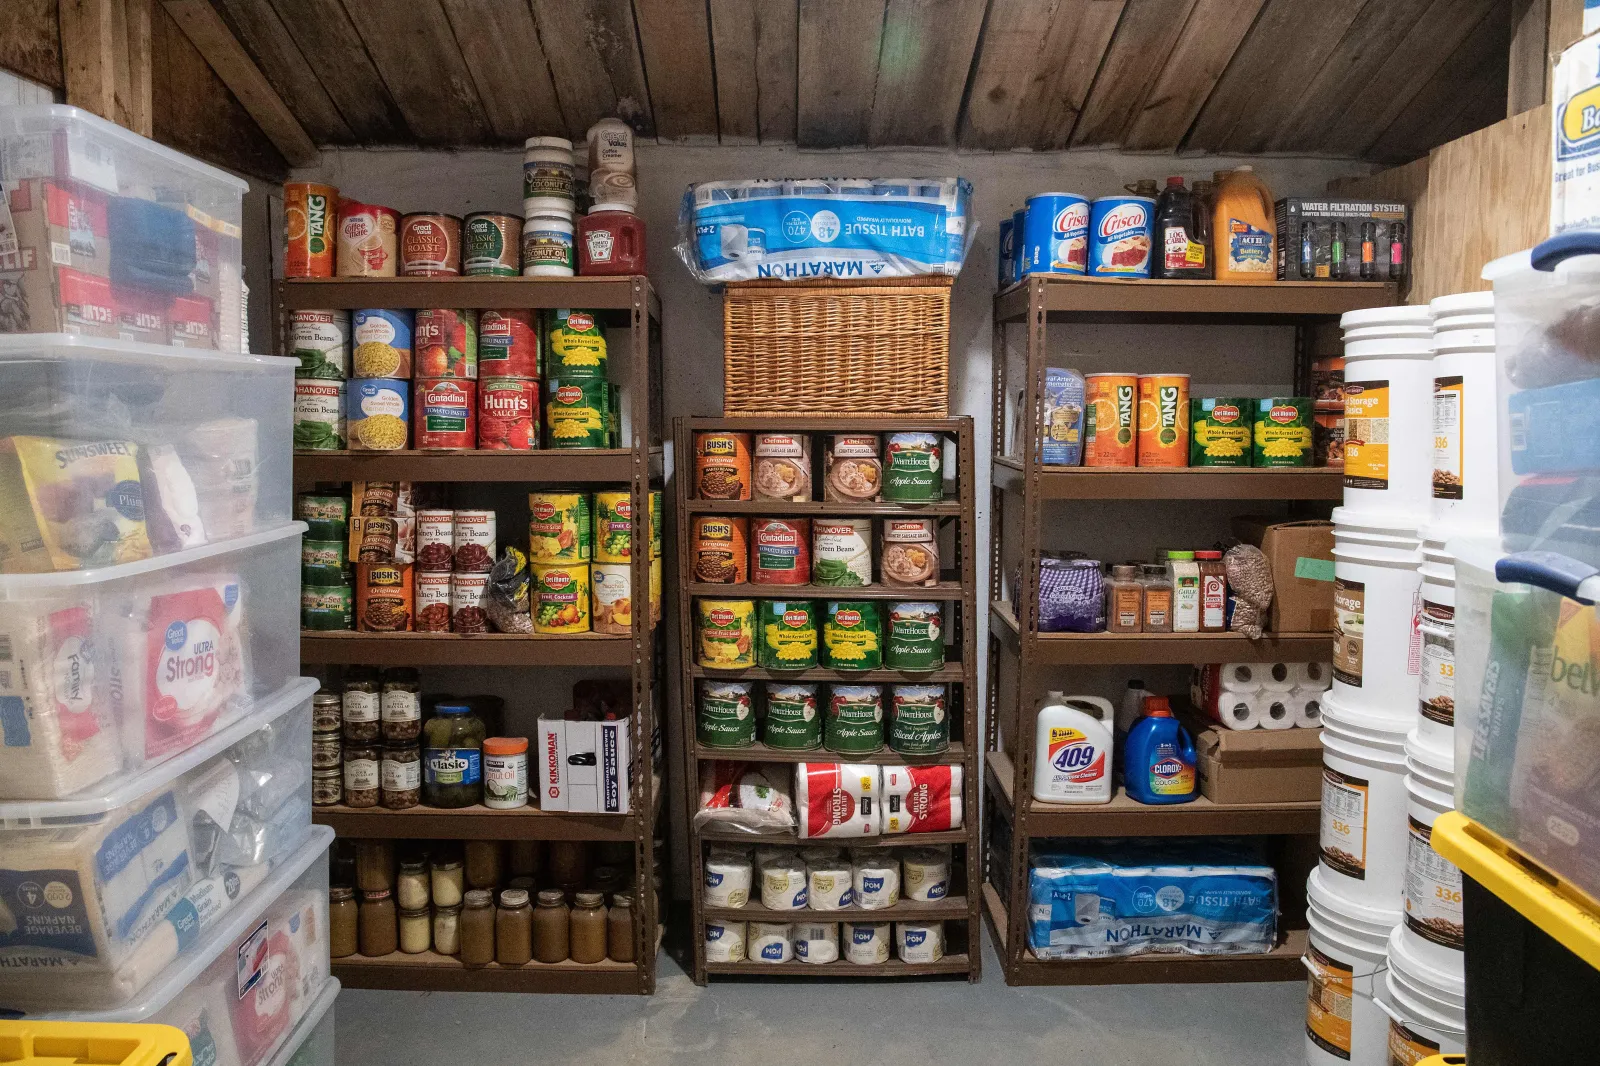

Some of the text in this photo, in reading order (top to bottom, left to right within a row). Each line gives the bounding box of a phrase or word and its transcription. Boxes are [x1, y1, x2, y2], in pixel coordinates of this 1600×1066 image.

[601, 130, 627, 141] Great
[532, 180, 562, 189] COCONUT
[1302, 202, 1405, 212] WATER FILTRATION SYSTEM
[311, 194, 327, 236] TANG
[470, 222, 488, 230] Great
[1059, 210, 1088, 232] Crisco
[1103, 213, 1142, 236] Crisco
[345, 222, 367, 236] Coffee
[413, 224, 432, 232] Great
[697, 226, 715, 234] 2-PLY
[788, 224, 807, 236] 470
[818, 225, 834, 238] 48
[845, 222, 924, 237] BATH TISSUE
[406, 236, 441, 244] CLASSIC
[407, 244, 440, 252] ROAST
[757, 259, 863, 278] MARATHON
[295, 314, 332, 322] HANOVER
[314, 334, 335, 342] Beans
[1057, 376, 1075, 384] Artery
[299, 386, 338, 395] HANOVER
[428, 393, 464, 404] Contadina
[484, 394, 528, 411] Hunt's
[1349, 396, 1378, 408] Storage
[299, 405, 319, 413] Green
[1120, 386, 1133, 427] TANG
[1161, 386, 1178, 428] TANG
[707, 440, 733, 450] BUSH'S
[1434, 436, 1448, 449] 336
[55, 441, 130, 469] SUNSWEET
[1347, 447, 1359, 457] 336
[890, 476, 933, 486] Apple Sauce
[366, 490, 394, 499] Original
[367, 521, 391, 531] BUSH'S
[703, 525, 729, 535] BUSH'S
[818, 527, 851, 535] HANOVER
[470, 530, 489, 538] Beans
[760, 533, 794, 542] Contadina
[364, 537, 391, 545] Original
[818, 545, 855, 553] Green Beans
[371, 570, 399, 580] BUSH'S
[1178, 588, 1197, 596] GARLIC
[168, 628, 184, 638] Great
[194, 640, 214, 654] ULTRA
[891, 645, 932, 654] Apple Sauce
[166, 653, 214, 682] Strong
[67, 654, 83, 701] Family
[1491, 697, 1506, 738] MINTS
[701, 721, 740, 732] Apple Sauce
[767, 724, 807, 734] Apple Sauce
[836, 728, 878, 737] Apple Sauce
[894, 729, 941, 742] Sliced Apples
[548, 733, 557, 785] KIKKOMAN
[1055, 746, 1095, 768] 409
[609, 729, 618, 808] Soy Sauce
[505, 771, 515, 779] Oil
[604, 758, 612, 809] TRADITIONALLY
[832, 787, 843, 826] STRONG
[841, 796, 849, 817] ULTRA
[912, 791, 920, 814] ULTRA
[919, 783, 929, 822] STRONG
[1332, 819, 1350, 835] 336
[864, 880, 881, 889] POM
[1054, 890, 1072, 900] 2-PLY
[1435, 885, 1462, 903] 336
[1137, 898, 1154, 907] 470
[1162, 898, 1178, 908] 48
[1188, 894, 1230, 907] TISSUE
[26, 915, 76, 925] NAPKINS
[129, 893, 175, 945] MARATHON
[177, 912, 195, 930] Great
[25, 925, 82, 935] BEVERAGE
[1106, 924, 1202, 943] MARATHON
[854, 932, 871, 940] POM
[906, 935, 923, 943] POM
[765, 946, 782, 955] POM
